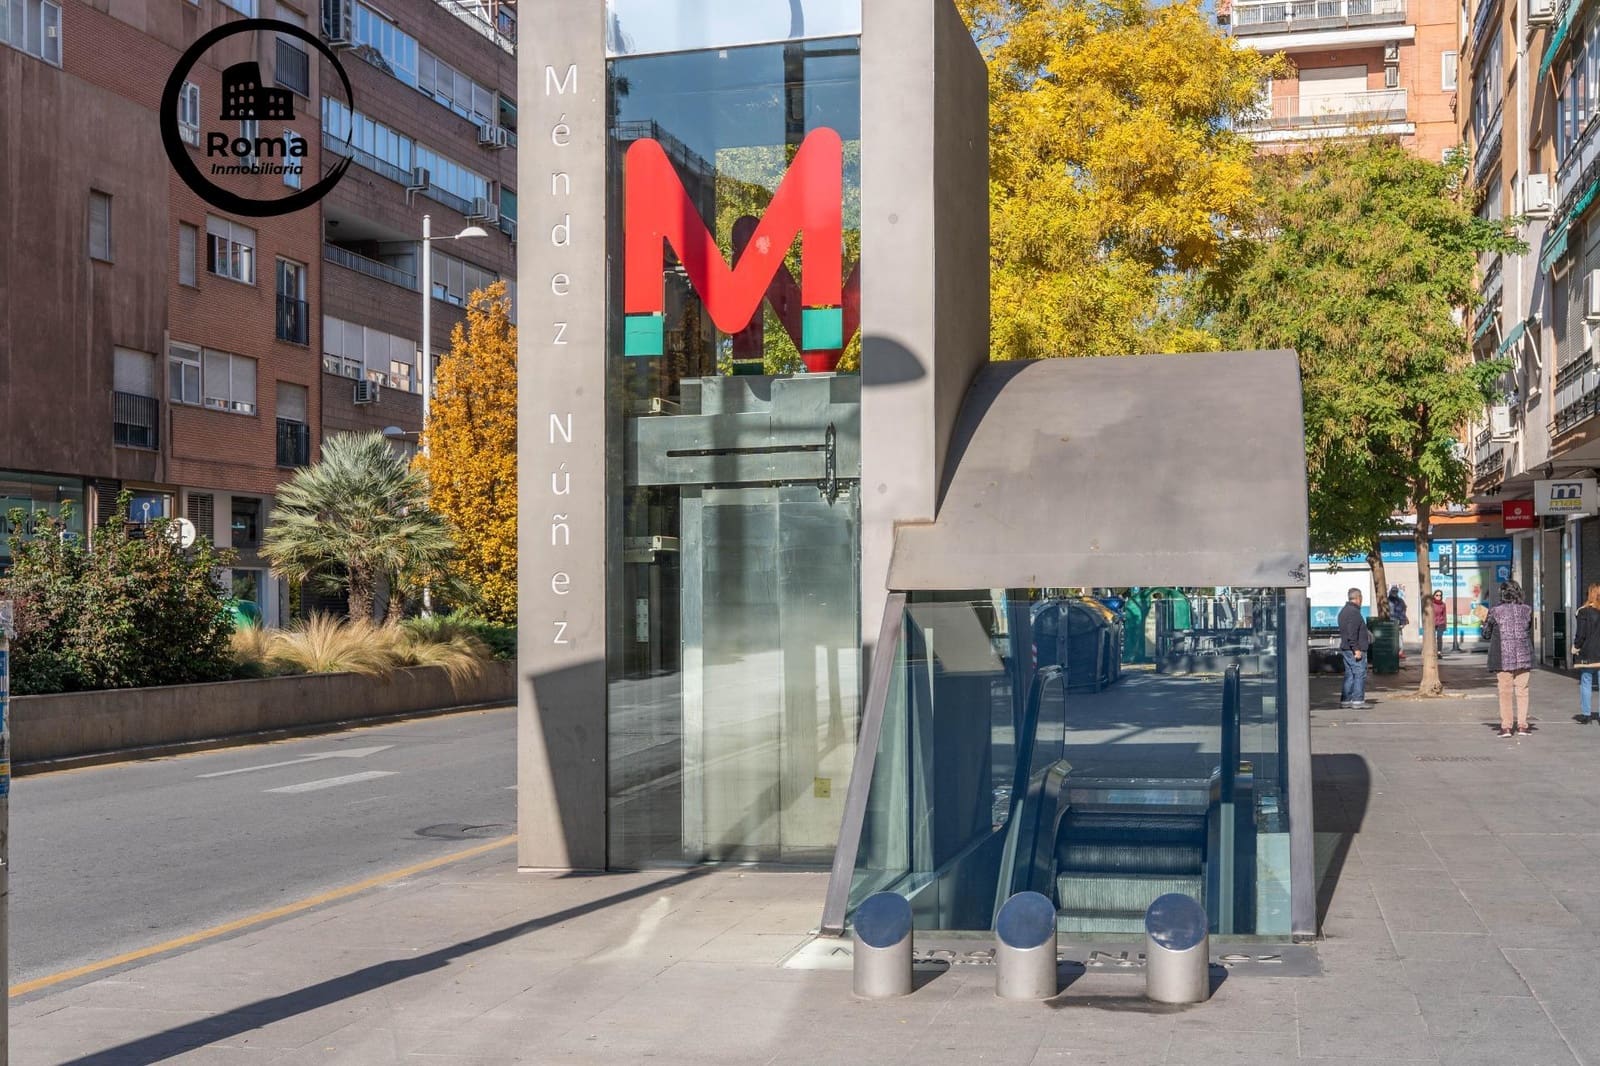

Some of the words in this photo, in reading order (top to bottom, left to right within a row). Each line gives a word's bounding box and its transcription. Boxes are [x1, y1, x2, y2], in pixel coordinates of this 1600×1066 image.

[545, 64, 578, 346] Méndez
[549, 413, 572, 644] Núñez
[1463, 545, 1485, 554] 292
[1488, 544, 1507, 554] 317
